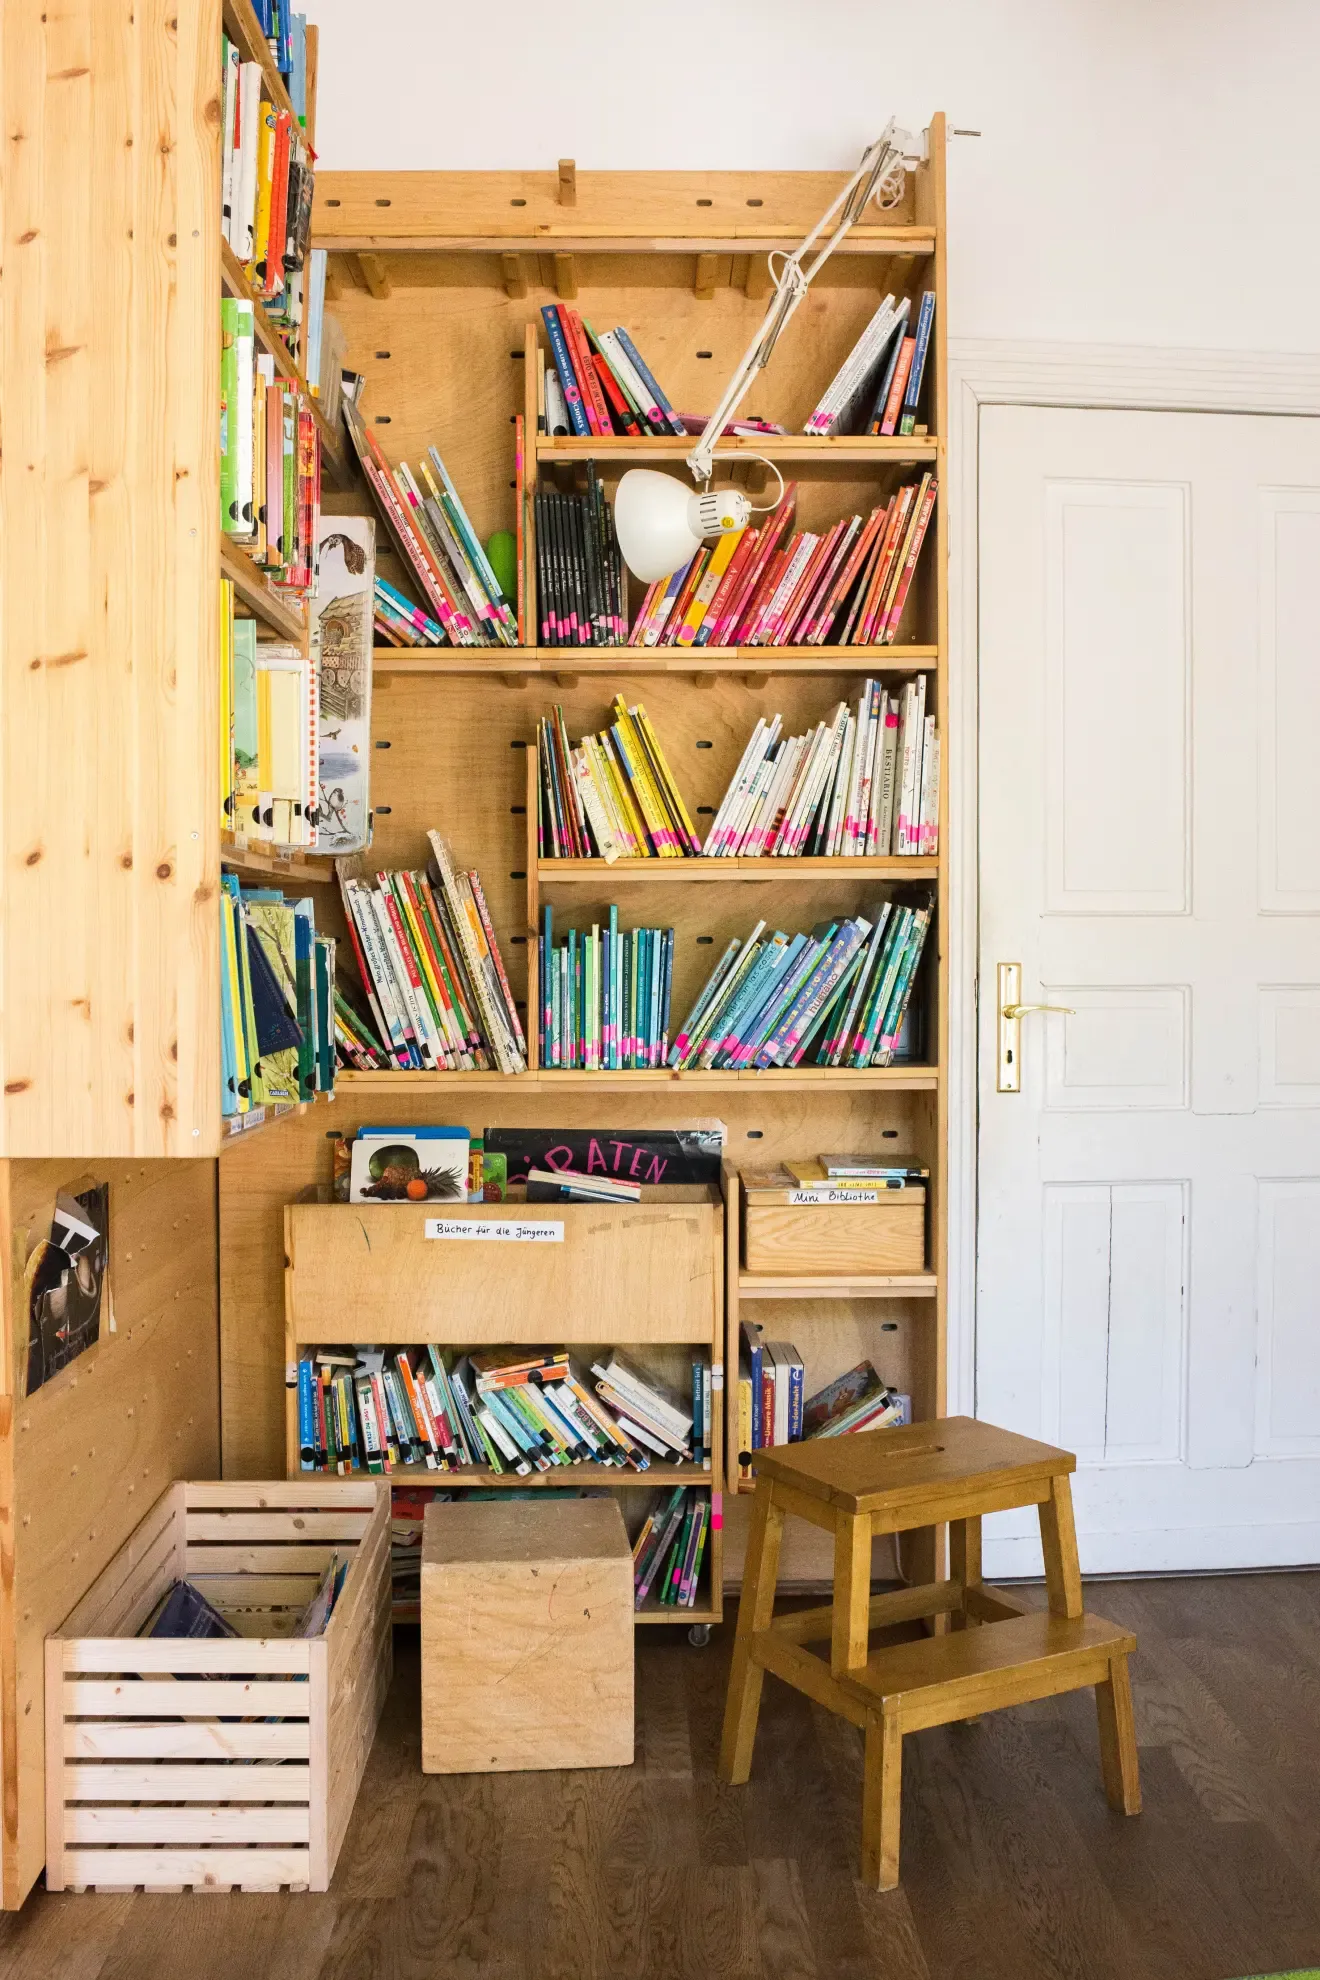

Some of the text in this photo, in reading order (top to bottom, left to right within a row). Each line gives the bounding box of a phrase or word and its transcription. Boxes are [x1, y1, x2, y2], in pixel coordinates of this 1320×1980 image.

[918, 497, 932, 526] PALABRAS
[720, 574, 733, 595] contar
[882, 749, 892, 799] BESTIARIO
[368, 950, 381, 970] großes
[748, 970, 759, 984] las
[757, 945, 777, 971] cosas
[374, 970, 382, 983] Mein
[794, 1191, 875, 1202] Mini Bibliothe
[436, 1223, 555, 1239] Bücher für die Jüngeren
[574, 1405, 601, 1436] FARBEN
[584, 1397, 613, 1428] Bauernhof
